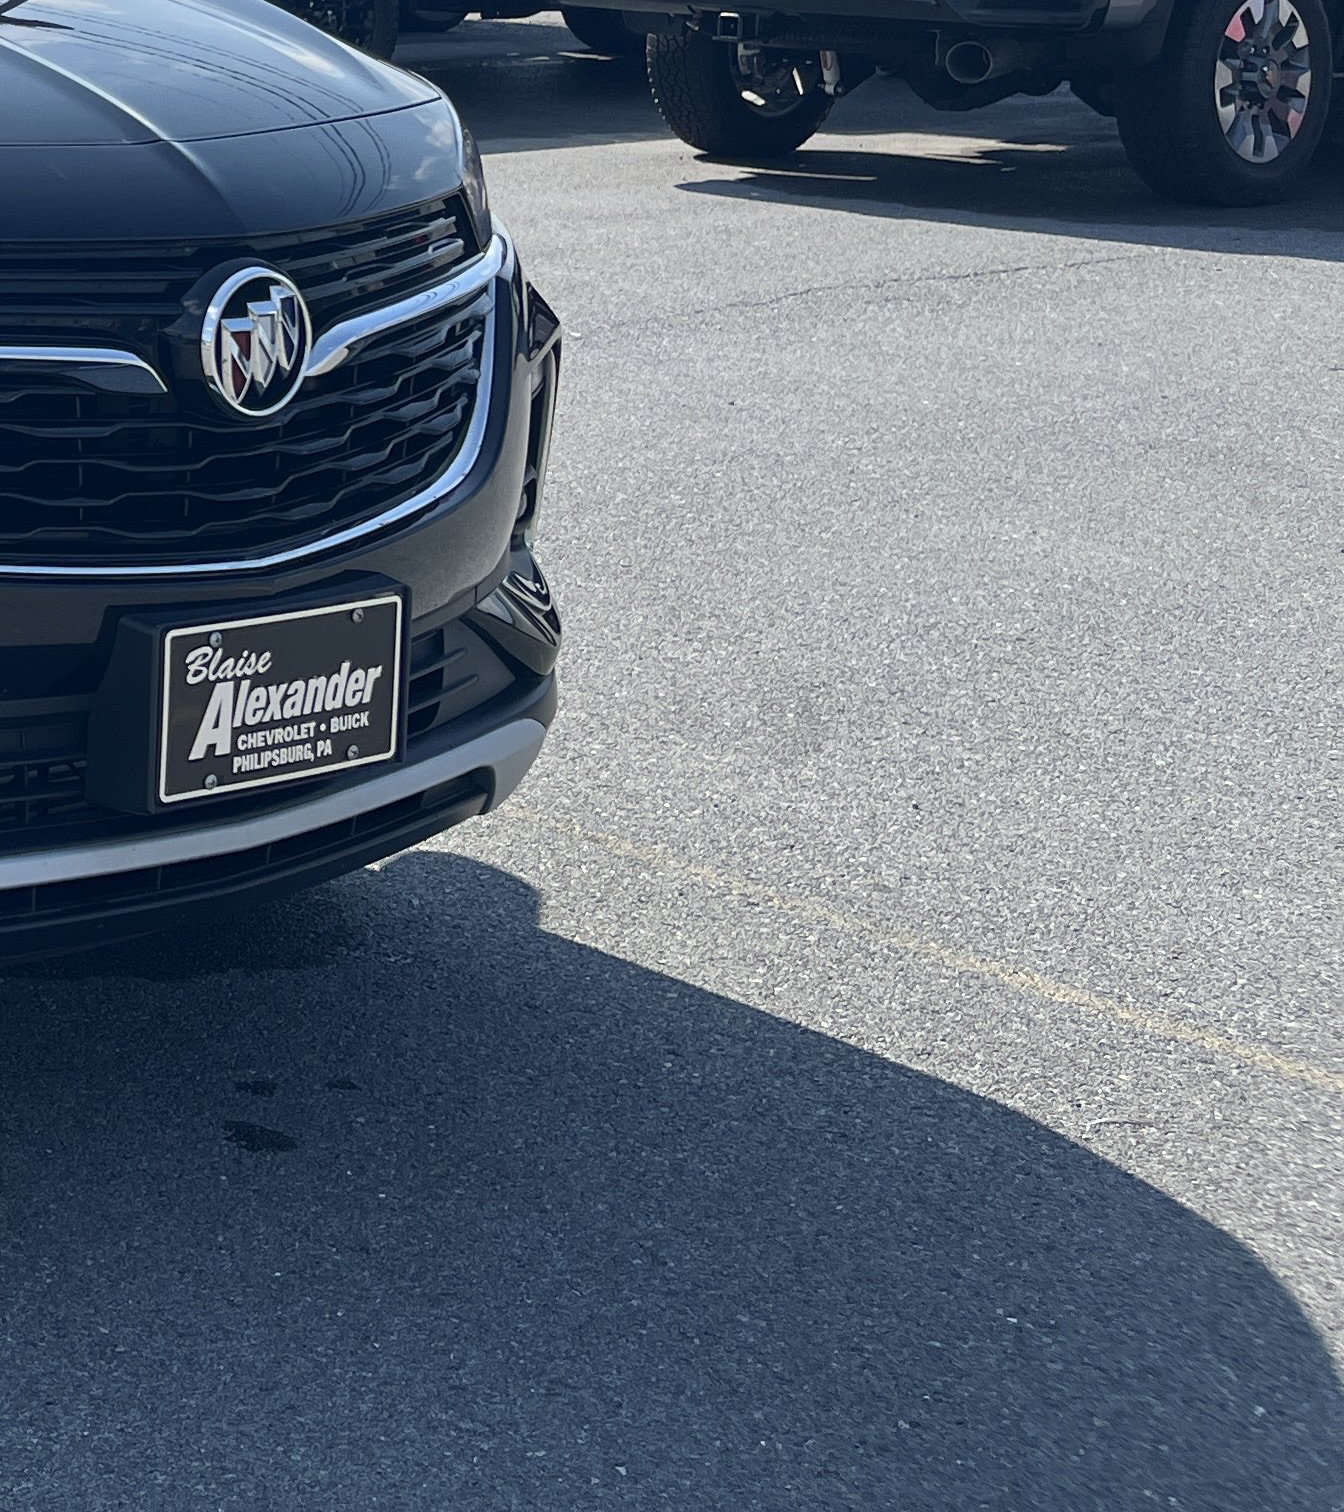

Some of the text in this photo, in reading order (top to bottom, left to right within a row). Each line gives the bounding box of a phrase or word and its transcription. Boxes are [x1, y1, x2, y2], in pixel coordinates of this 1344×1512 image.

[185, 645, 273, 685] Blaise
[188, 660, 383, 761] Alexander
[237, 711, 370, 751] CHEVROLET BUICK
[232, 739, 333, 774] PHILIPSBURG, PA
